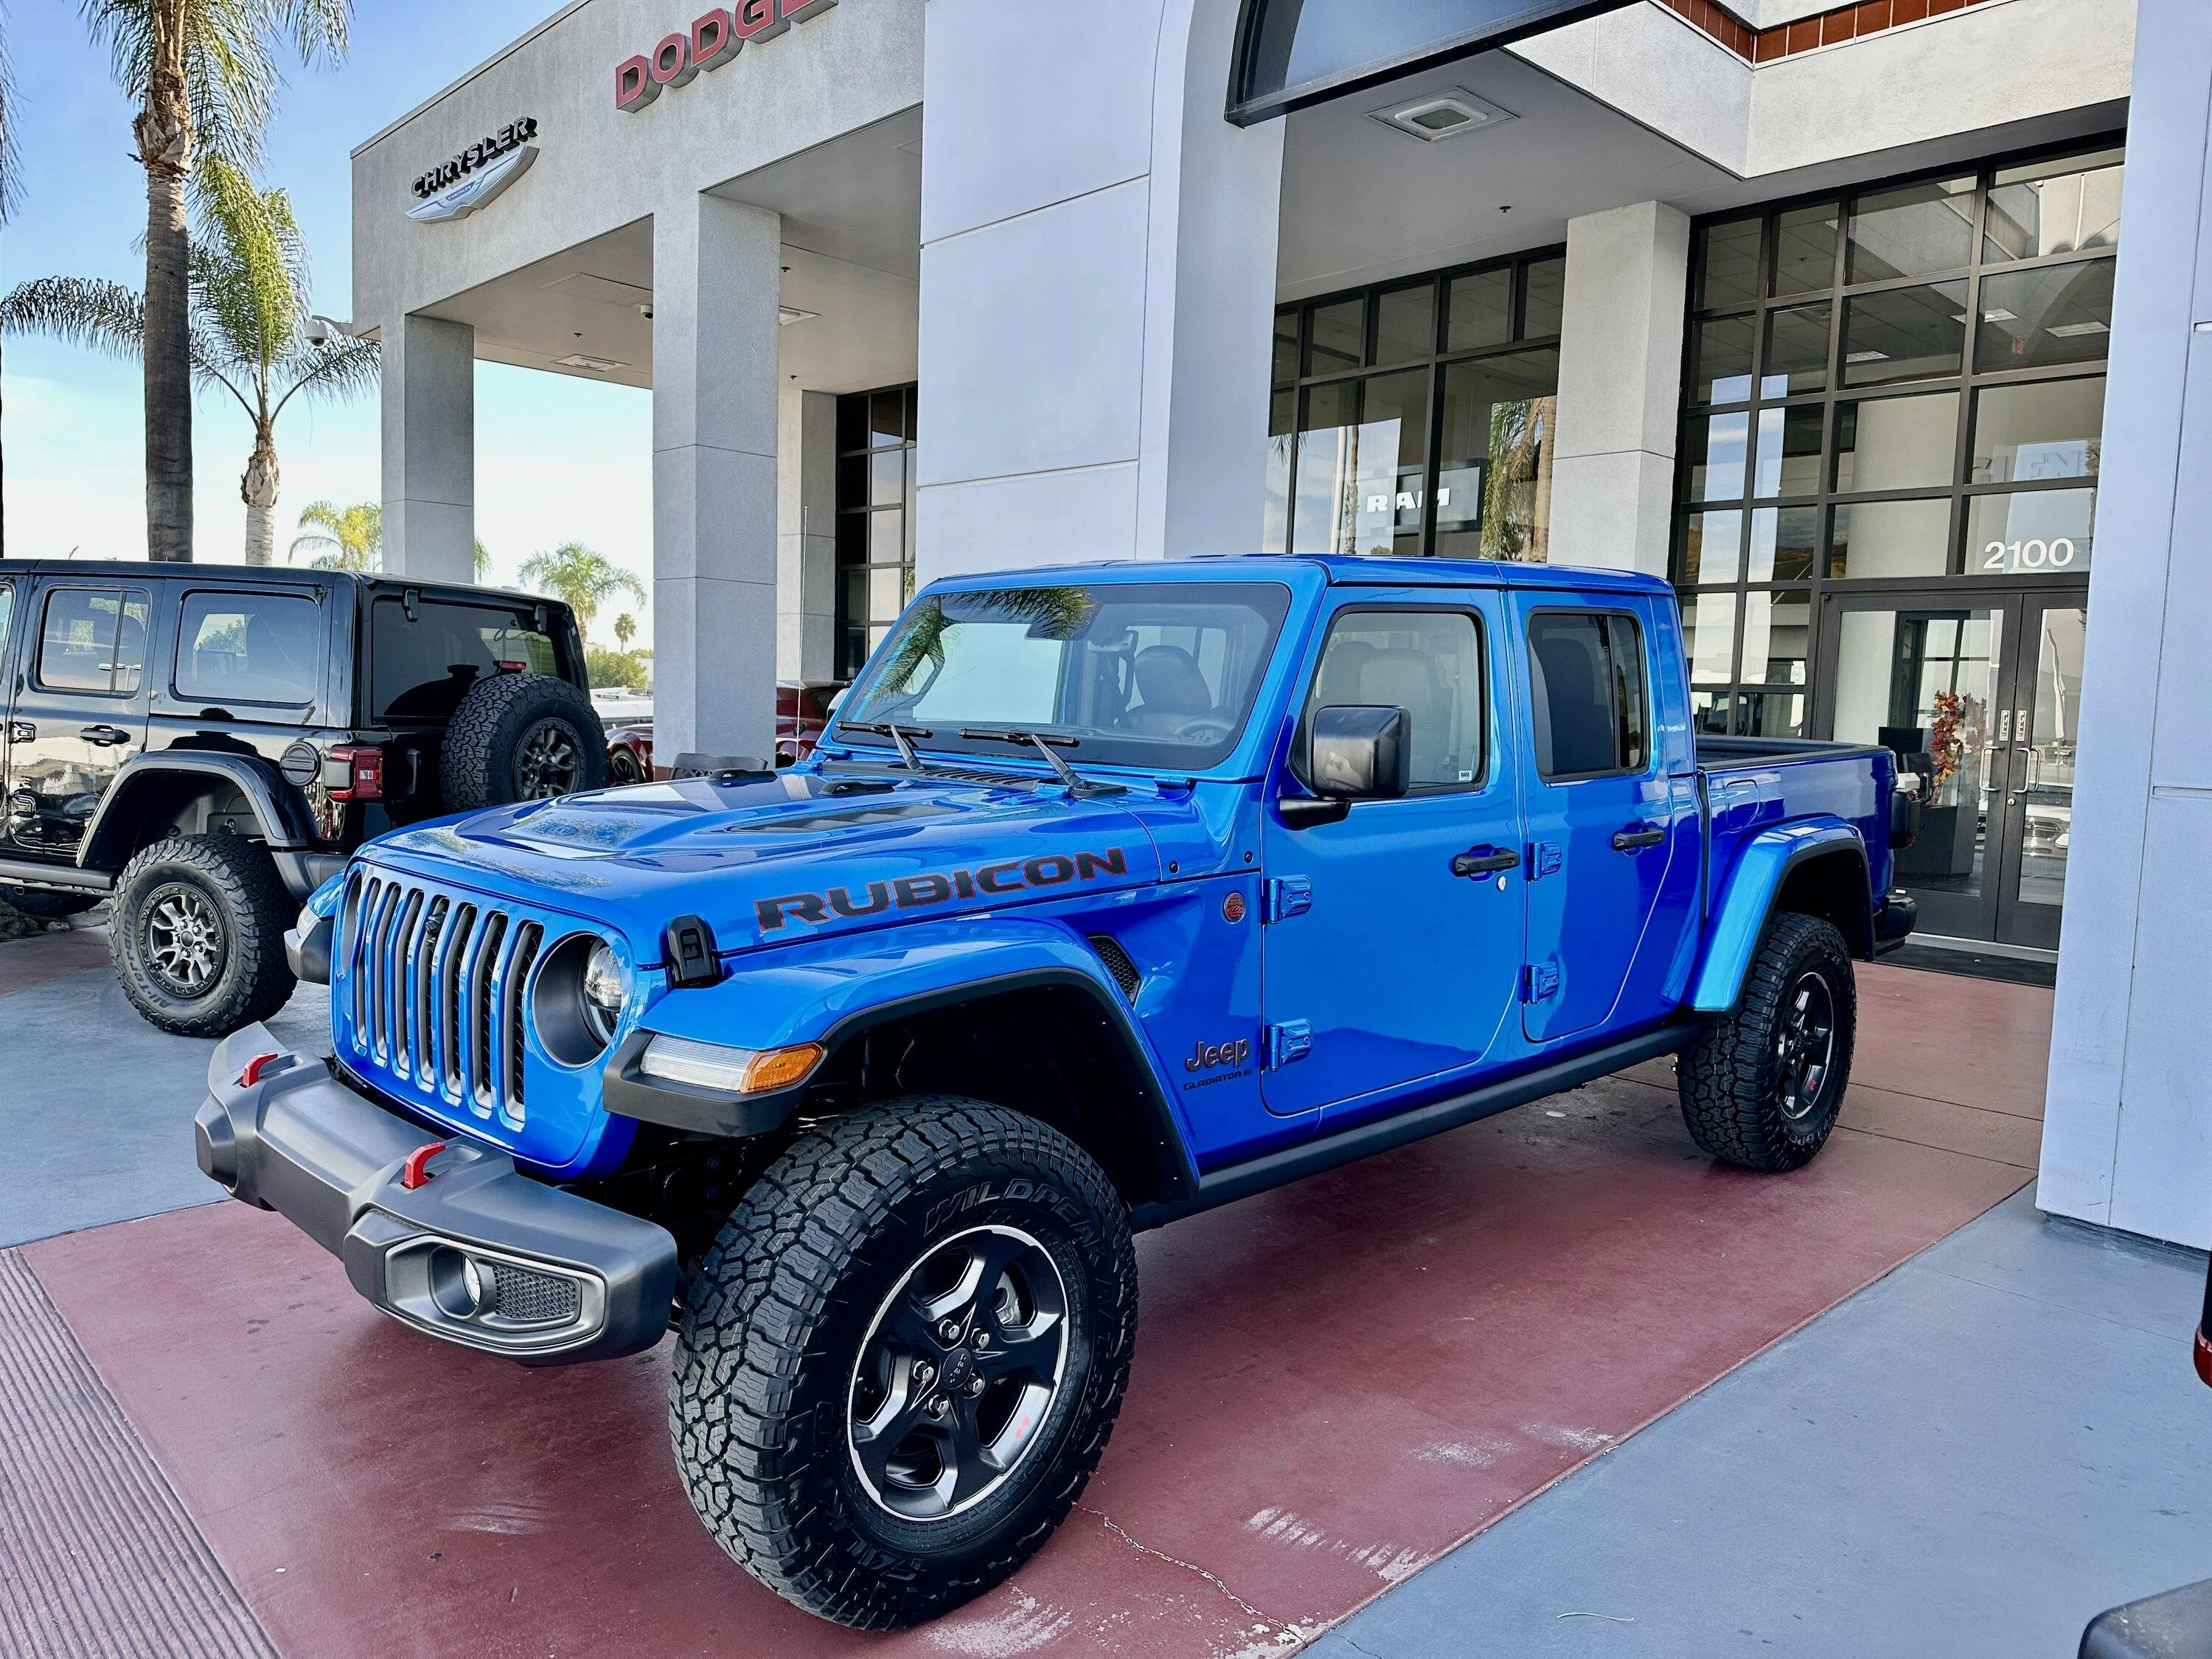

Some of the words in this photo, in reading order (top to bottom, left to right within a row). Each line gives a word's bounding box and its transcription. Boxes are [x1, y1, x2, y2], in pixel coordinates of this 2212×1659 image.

[411, 115, 533, 198] CHRYSLER
[1983, 538, 2075, 569] 2100
[754, 846, 1128, 931] RUBICON
[1183, 1071, 1242, 1091] GLADIATOR
[1186, 1038, 1249, 1072] Jeep
[923, 1178, 1106, 1265] WILDPEAK
